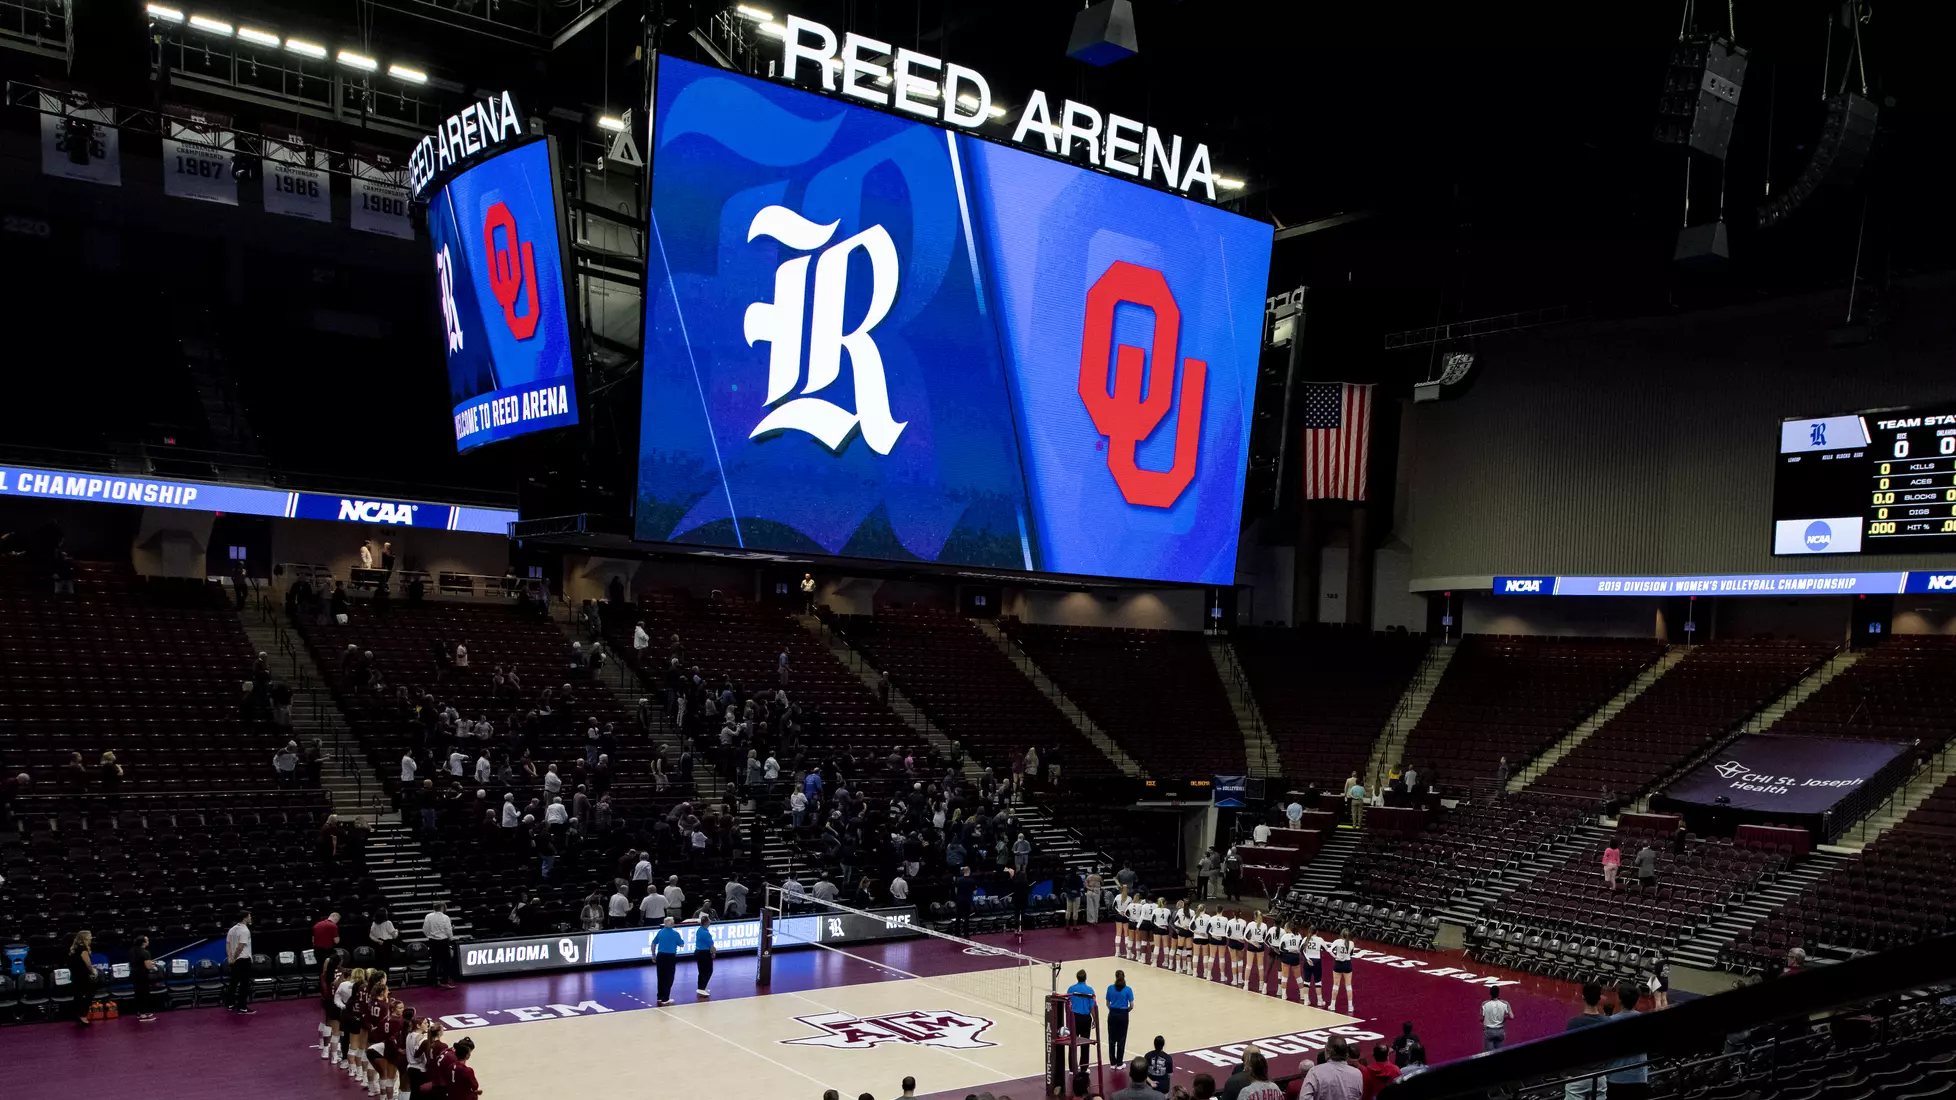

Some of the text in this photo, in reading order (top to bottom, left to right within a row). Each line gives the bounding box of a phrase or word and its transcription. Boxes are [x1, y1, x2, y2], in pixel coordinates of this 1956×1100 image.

[783, 13, 1217, 201] REED ARENA
[438, 90, 522, 172] ARENA
[176, 156, 223, 179] 1987
[275, 174, 319, 198] 1986
[362, 193, 403, 216] 1980
[484, 201, 540, 341] OU
[744, 204, 909, 456] R
[1077, 259, 1208, 509] OU
[478, 402, 491, 430] TO
[492, 394, 520, 427] REED
[522, 384, 568, 421] ARENA
[1877, 414, 1956, 430] TEAM STA
[1896, 432, 1908, 440] RICE
[1894, 440, 1909, 458] 0
[1940, 436, 1956, 455] 0
[1880, 462, 1935, 475] 0 KILLS
[18, 472, 198, 507] CHAMPIONSHIP
[1879, 478, 1890, 490] 0
[1873, 492, 1895, 504] 0.0
[1904, 493, 1937, 501] BLOCKS
[338, 500, 413, 525] NCAA
[1878, 507, 1930, 519] 0 DIGS
[1868, 522, 1896, 535] .000
[1907, 523, 1922, 531] HIT
[1806, 534, 1832, 544] NCAA
[1505, 580, 1540, 592] NCAA
[1598, 581, 1622, 592] 2019
[1624, 581, 1667, 592] DIVISION
[1675, 580, 1718, 592] WOMEN'S
[1720, 579, 1775, 591] VOLLEYBALL
[1778, 577, 1857, 590] CHAMPIONSHIP
[1730, 781, 1788, 795] Health
[1741, 773, 1864, 788] CHI St. Joseph
[886, 914, 911, 930] RICE
[1216, 921, 1221, 929] 9
[559, 938, 580, 963] OU
[1289, 939, 1297, 947] 18
[1307, 942, 1317, 950] 22
[467, 944, 550, 966] OKLAHOMA
[384, 1022, 390, 1034] 8
[1184, 1025, 1386, 1068] AGGIES
